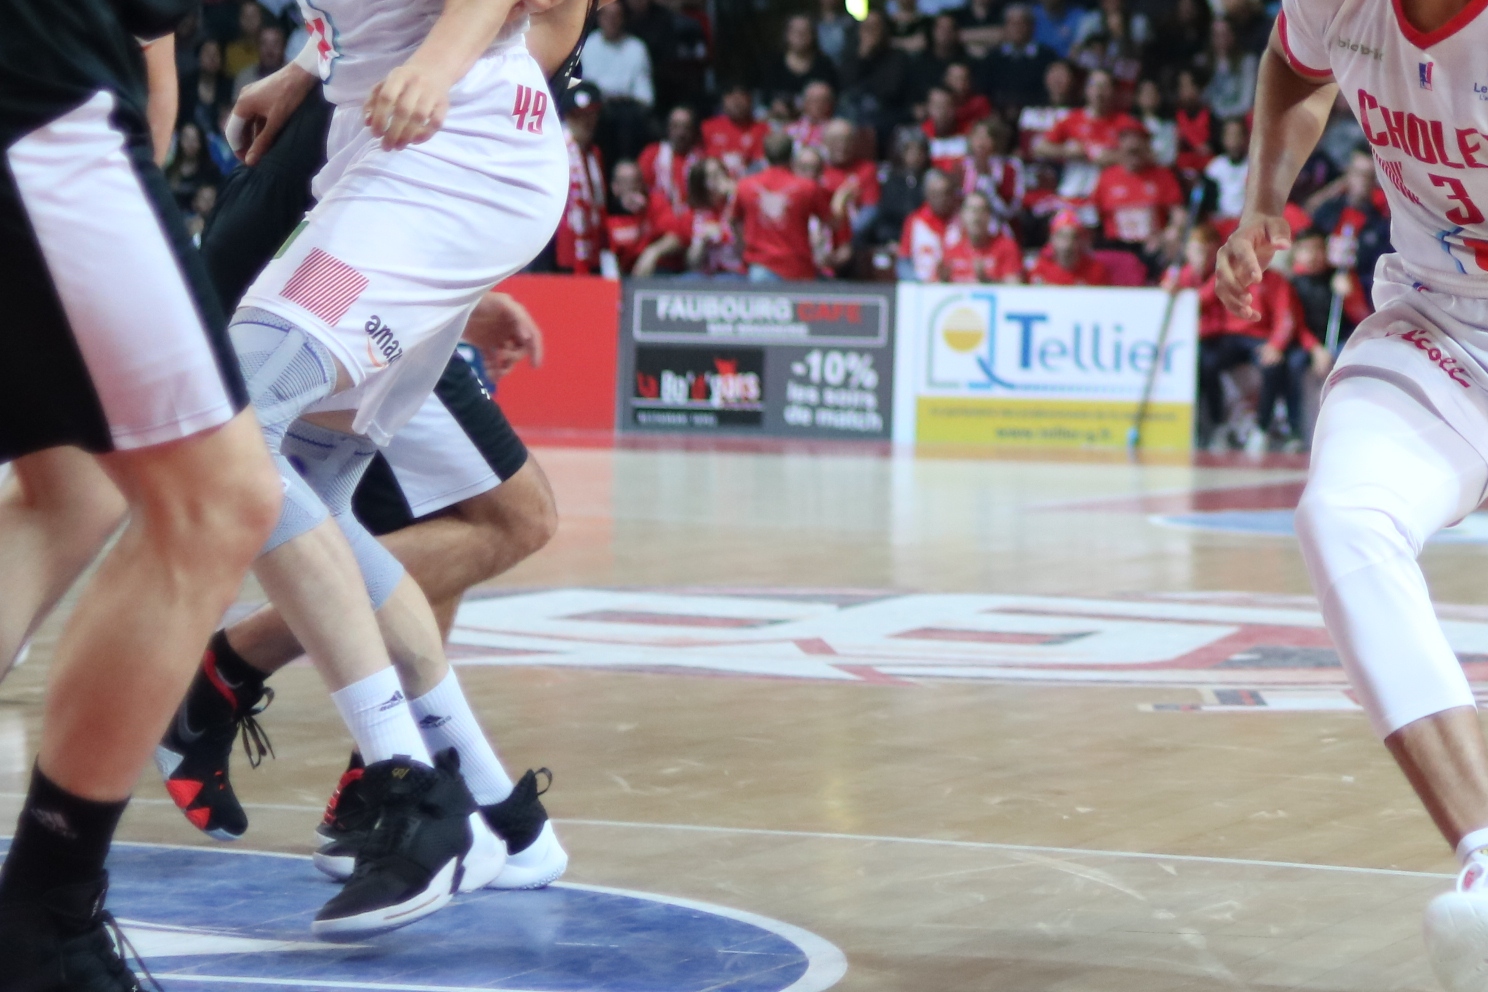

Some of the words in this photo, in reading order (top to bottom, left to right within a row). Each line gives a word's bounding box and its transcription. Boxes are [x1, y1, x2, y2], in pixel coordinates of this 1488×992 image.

[1473, 82, 1488, 94] Le
[511, 83, 548, 135] 49
[1428, 173, 1486, 226] 3
[655, 295, 794, 322] FAUBOURG
[1004, 312, 1186, 374] Tellier
[790, 349, 880, 390] -10%
[822, 385, 879, 411] soirs
[815, 407, 884, 433] match
